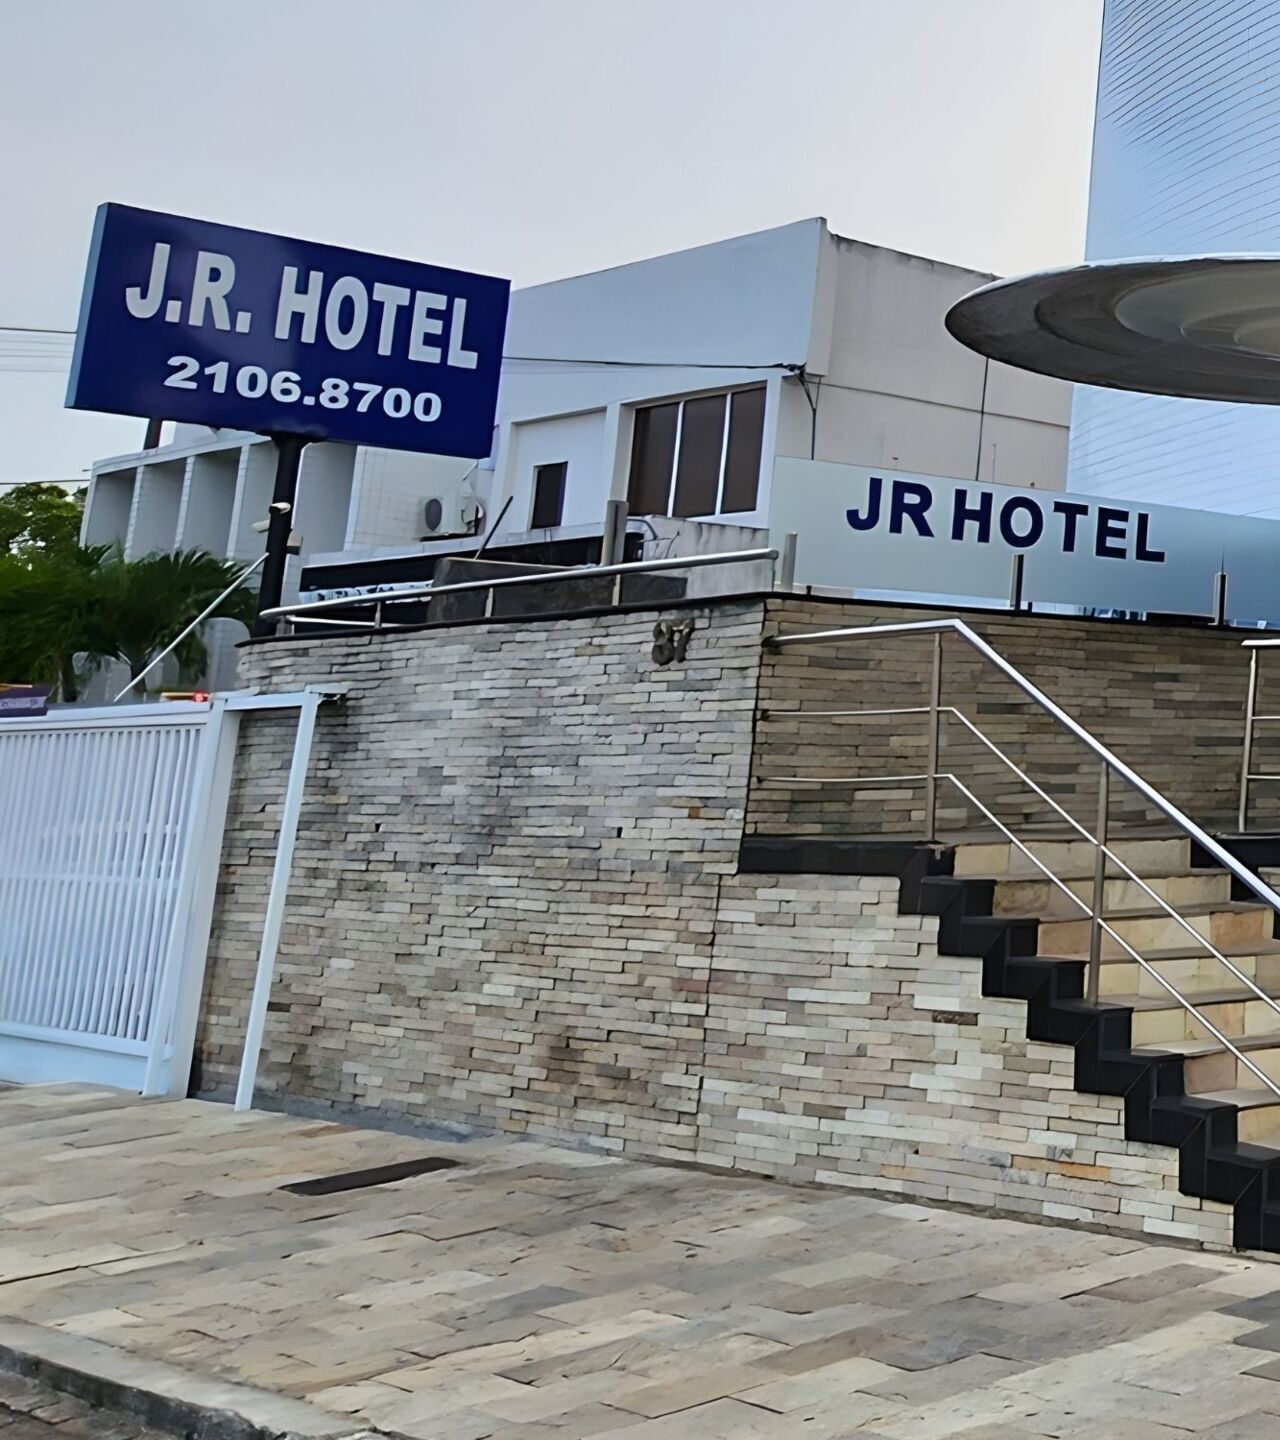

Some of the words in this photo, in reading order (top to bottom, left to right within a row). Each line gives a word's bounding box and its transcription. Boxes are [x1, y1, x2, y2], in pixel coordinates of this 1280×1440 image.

[125, 242, 252, 334] J.R.
[274, 265, 479, 370] HOTEL
[164, 355, 442, 423] 2106.8700
[846, 477, 935, 539] JR
[951, 488, 1166, 564] HOTEL
